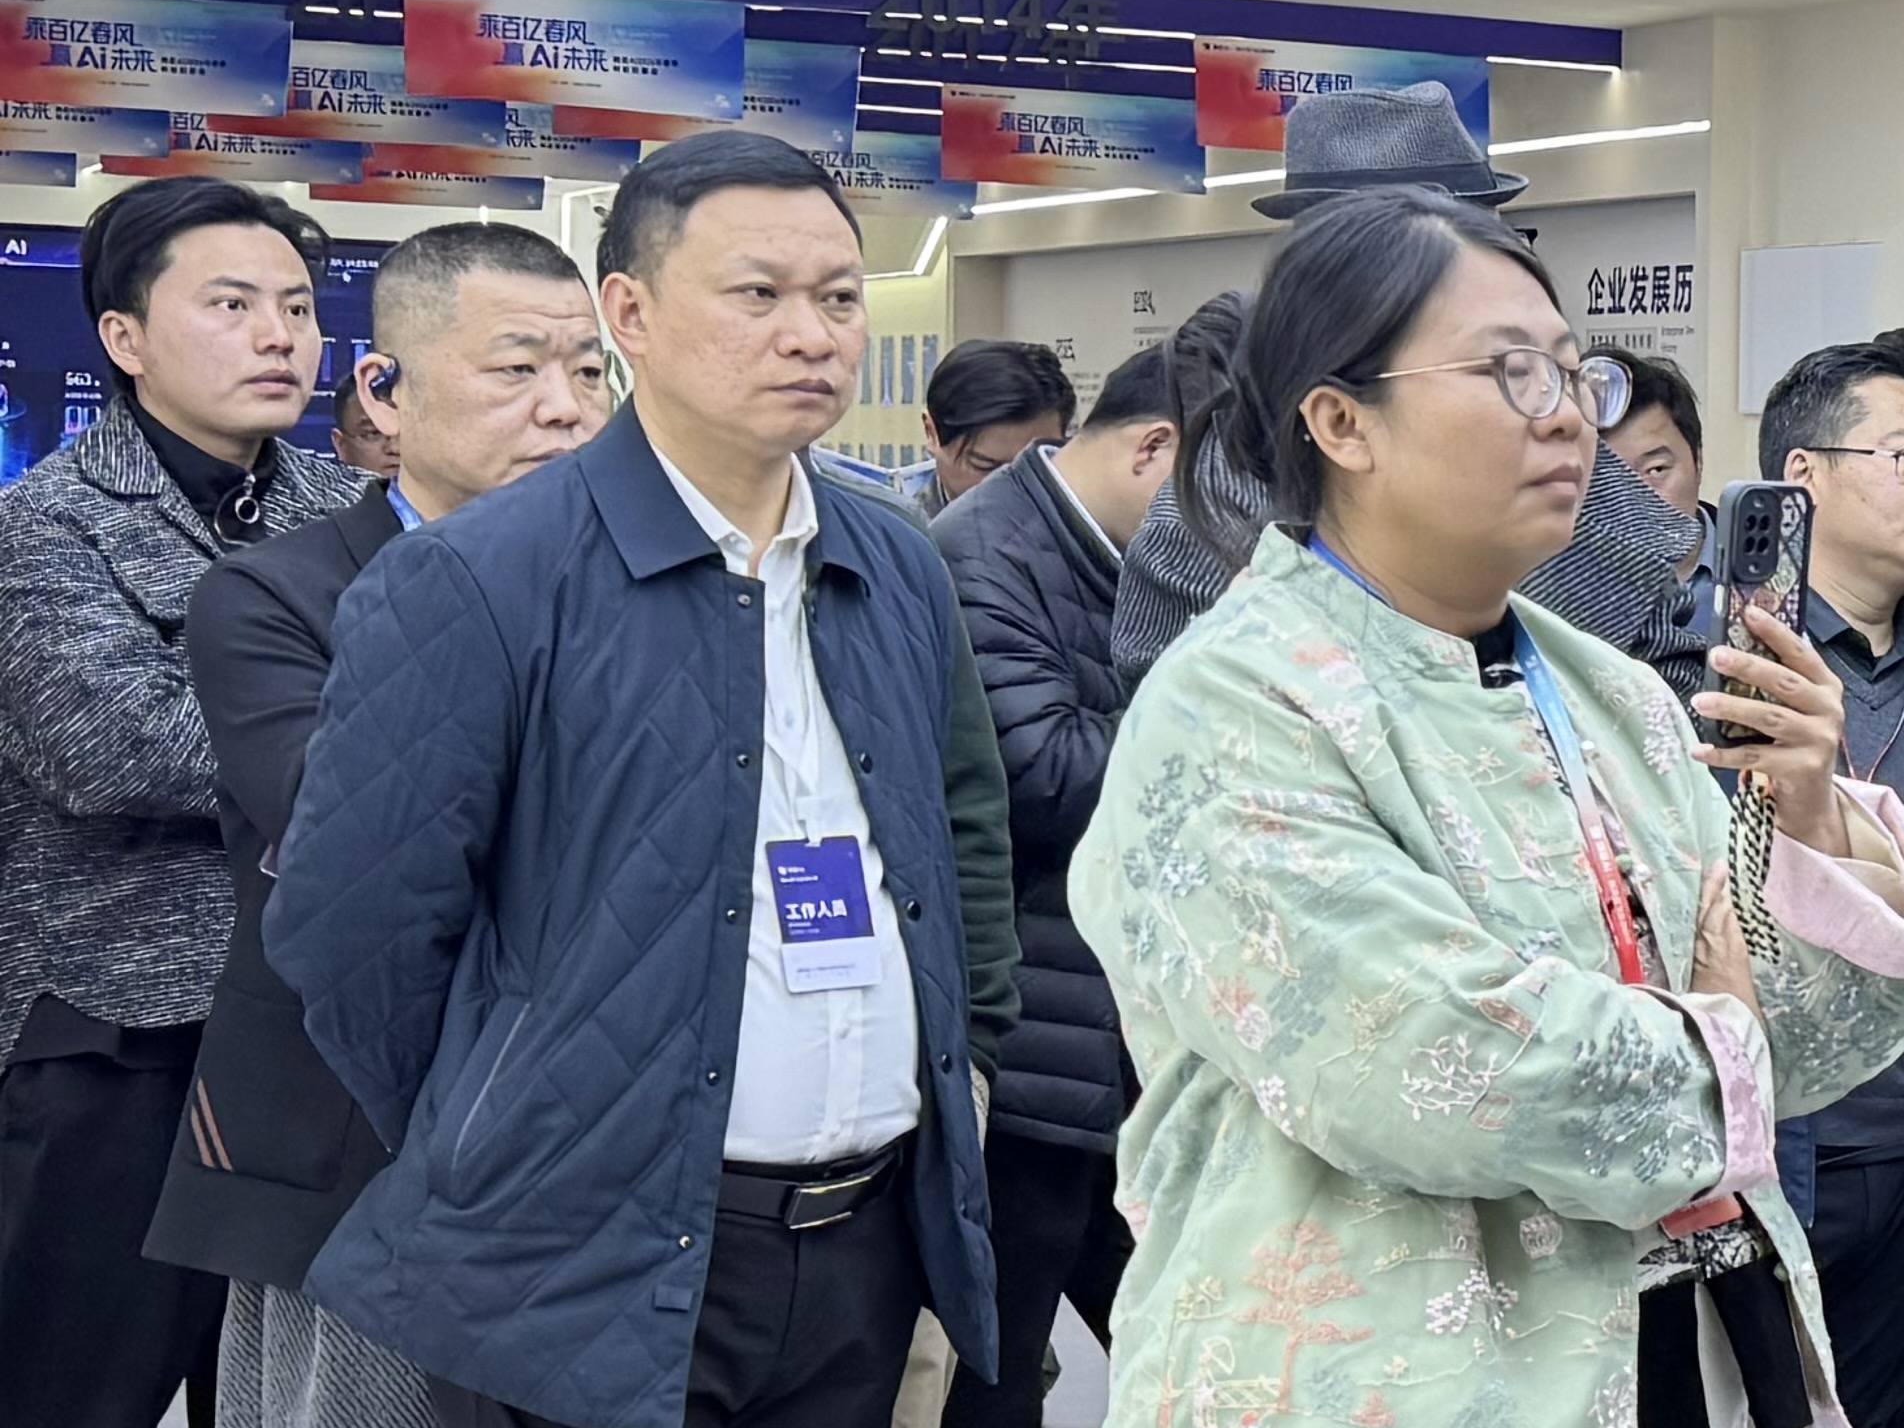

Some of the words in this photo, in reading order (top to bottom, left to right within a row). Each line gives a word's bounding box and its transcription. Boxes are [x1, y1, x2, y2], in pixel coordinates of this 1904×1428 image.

[475, 13, 596, 45] 乘百亿春风
[1587, 264, 1695, 315] 企业发展历
